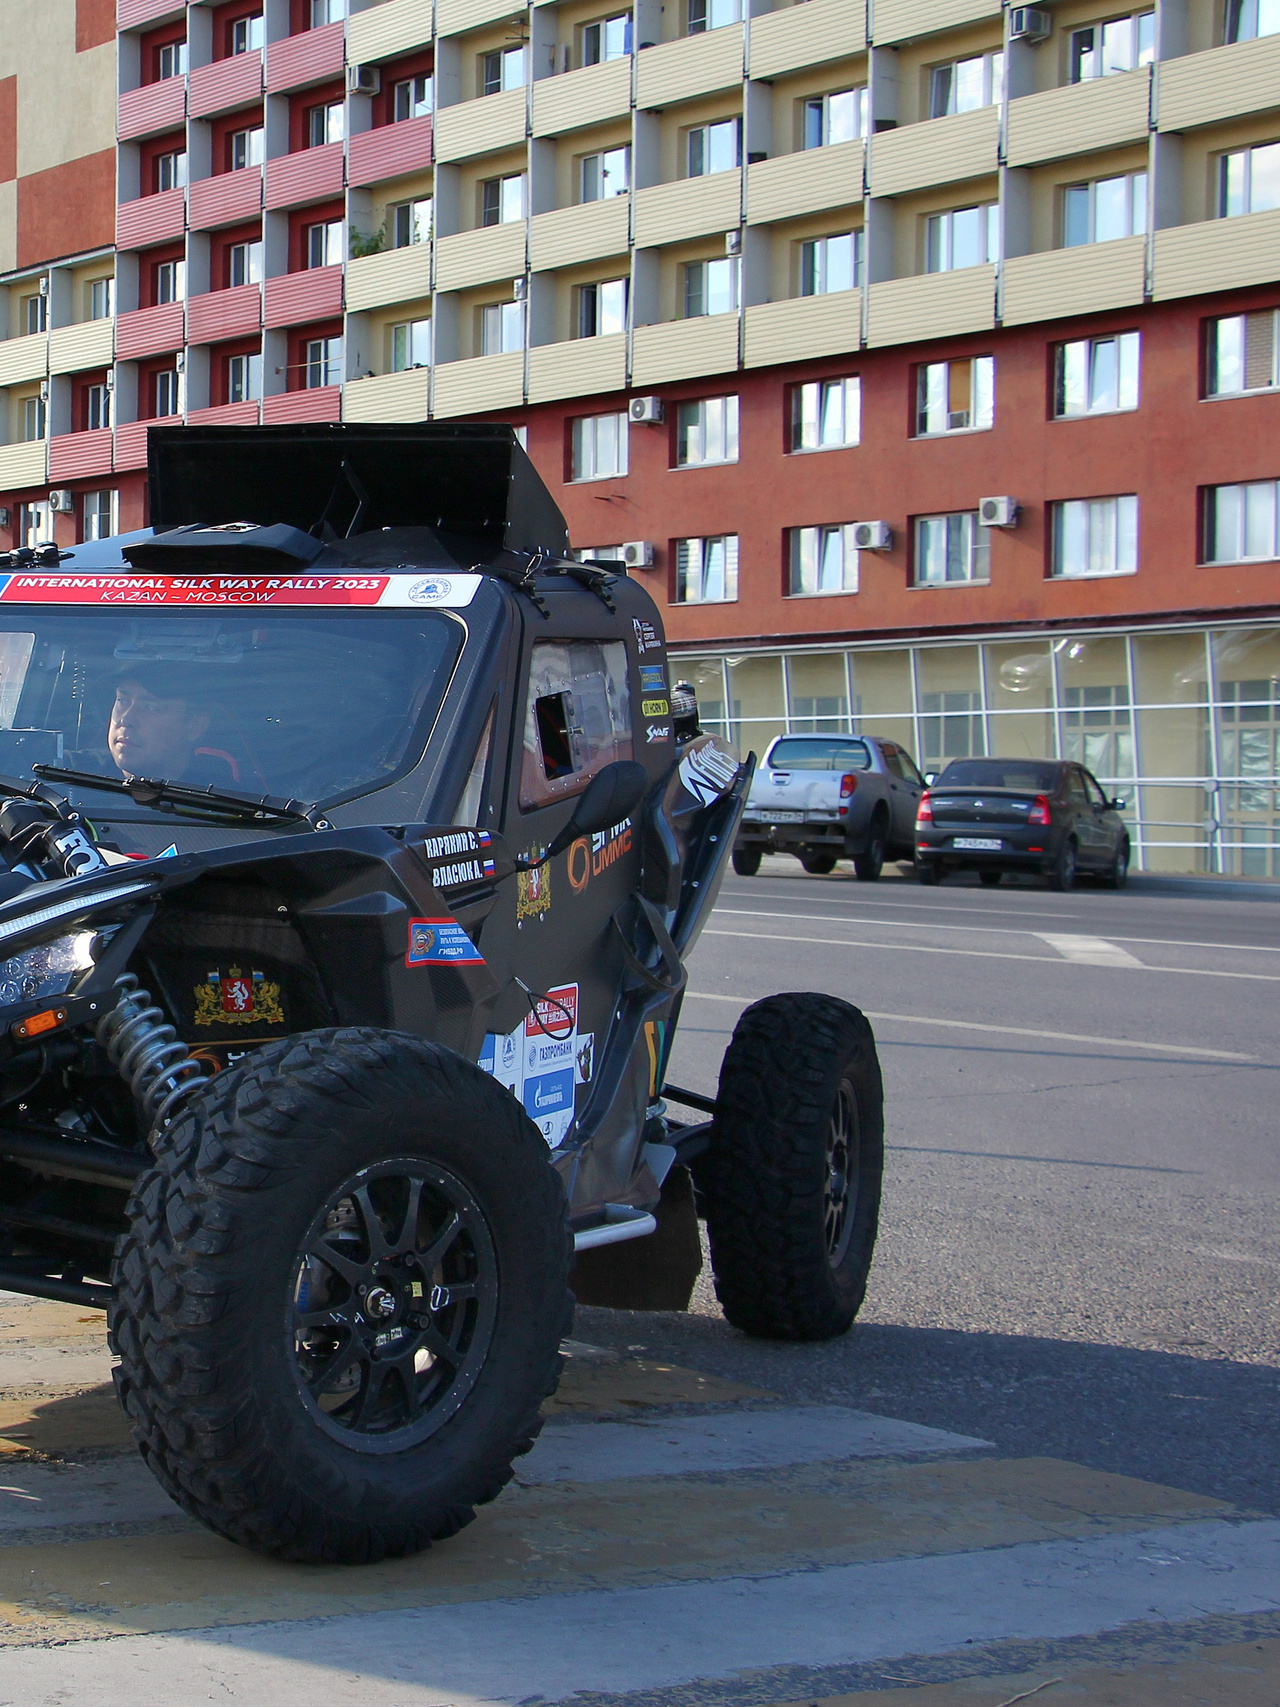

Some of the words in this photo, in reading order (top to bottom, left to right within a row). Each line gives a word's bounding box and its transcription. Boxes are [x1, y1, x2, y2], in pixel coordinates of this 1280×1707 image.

[16, 578, 166, 589] INTERNATIONAL
[170, 579, 214, 589] SILK
[219, 579, 264, 589] WAY
[265, 579, 333, 590] RALLY
[332, 580, 380, 590] 2023
[99, 591, 167, 601] KAZAN
[185, 591, 276, 602] MOSCOW
[54, 829, 108, 878] FO
[424, 832, 469, 859] КАРЯКИН
[467, 831, 479, 850] С.
[592, 829, 632, 876] UMMC
[432, 861, 474, 887] ВЛАСЮК
[473, 860, 483, 879] А.
